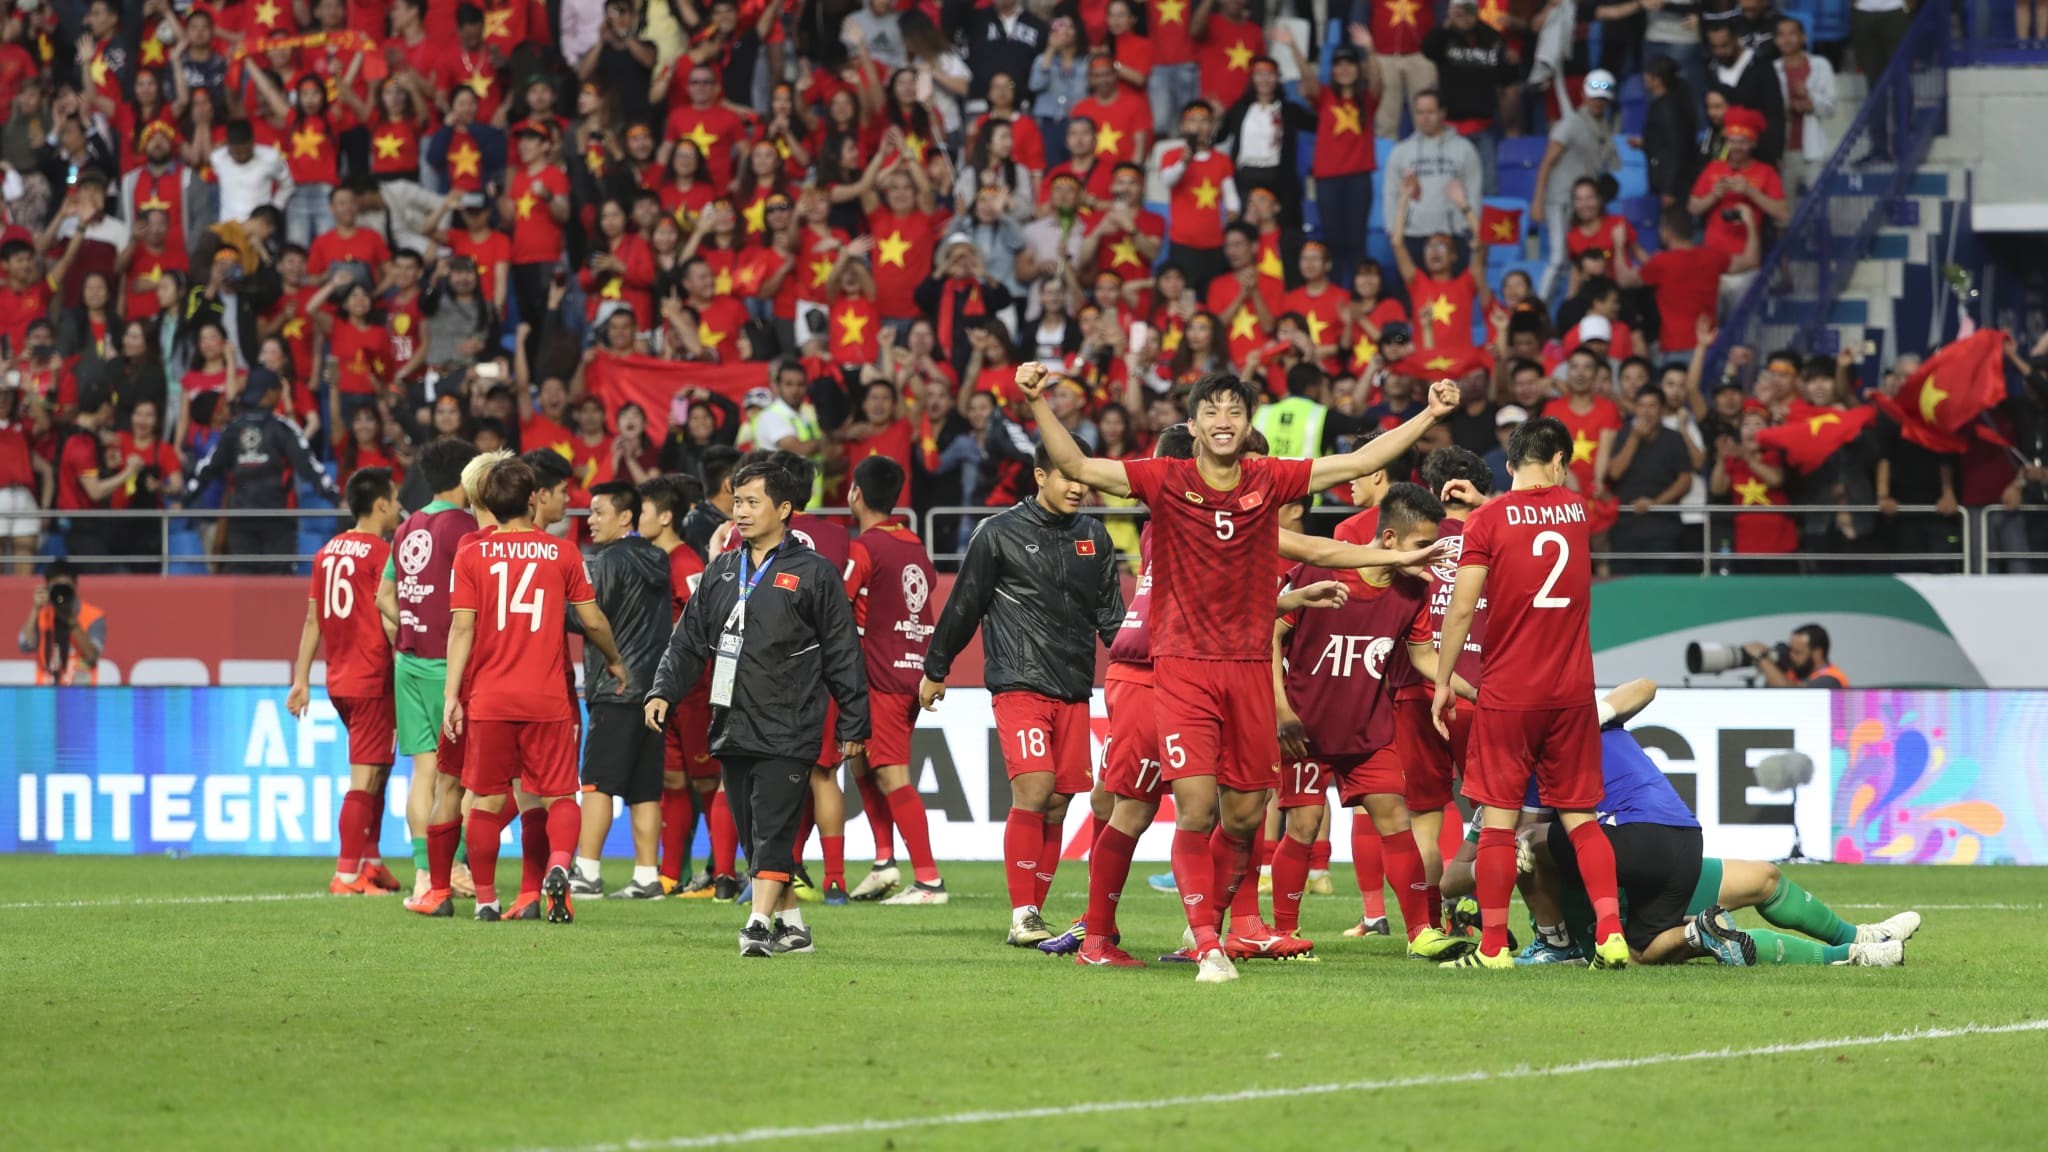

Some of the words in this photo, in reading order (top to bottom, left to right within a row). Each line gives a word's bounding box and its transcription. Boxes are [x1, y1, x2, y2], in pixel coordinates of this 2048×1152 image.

[1214, 510, 1235, 540] 5
[1506, 503, 1586, 525] D.D.MANH
[480, 541, 558, 560] T.M.VUONG
[1532, 530, 1571, 608] 2
[322, 555, 355, 619] 16
[489, 561, 545, 632] 14
[1439, 584, 1455, 594] AF
[1311, 634, 1395, 680] AFC
[244, 699, 349, 768] AF
[1016, 727, 1046, 760] 18
[1165, 733, 1186, 769] 5
[1135, 758, 1161, 793] 17
[1293, 762, 1320, 794] 12
[18, 774, 411, 841] INTEGRI
